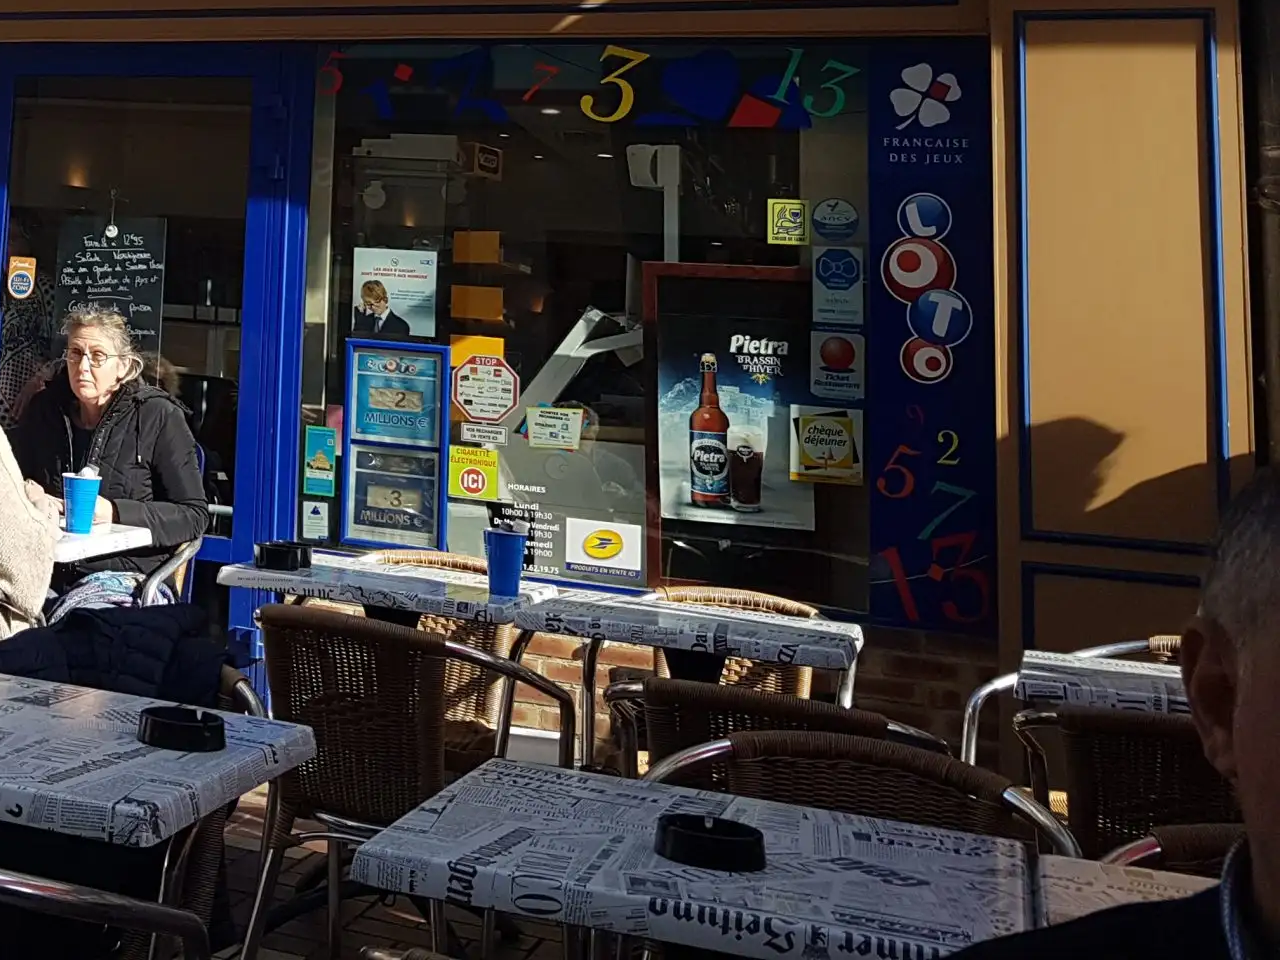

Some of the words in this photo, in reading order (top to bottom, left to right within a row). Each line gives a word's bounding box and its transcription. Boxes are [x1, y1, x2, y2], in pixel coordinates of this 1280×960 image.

[580, 45, 651, 122] 3
[889, 152, 918, 163] DES
[924, 154, 964, 165] JEUX
[729, 334, 789, 355] Pietra
[475, 357, 497, 366] STOP
[736, 355, 782, 367] BRASSIN
[395, 391, 406, 408] 2
[365, 412, 414, 427] MILLIONS
[807, 424, 844, 438] chèque
[804, 435, 848, 448] déjeuner
[937, 429, 960, 465] 2
[456, 448, 491, 458] CIGARETTE
[694, 449, 726, 463] Pietra
[451, 455, 497, 467] ÉLECTRONIQUE
[877, 444, 921, 498] 5
[464, 472, 483, 489] ICI
[508, 483, 546, 494] HORAIRES
[390, 490, 402, 507] 3
[514, 501, 539, 511] Lundi
[361, 510, 411, 526] MILLIONS
[502, 507, 523, 517] 10h00
[530, 510, 553, 520] 19h30
[531, 521, 560, 531] Vendredi
[530, 530, 553, 539] 19h30
[525, 540, 553, 549] amedi
[530, 548, 553, 557] 19h00
[570, 563, 599, 573] PRODUITS
[599, 566, 608, 574] EN
[608, 567, 628, 576] VENTE
[628, 569, 636, 577] ICI
